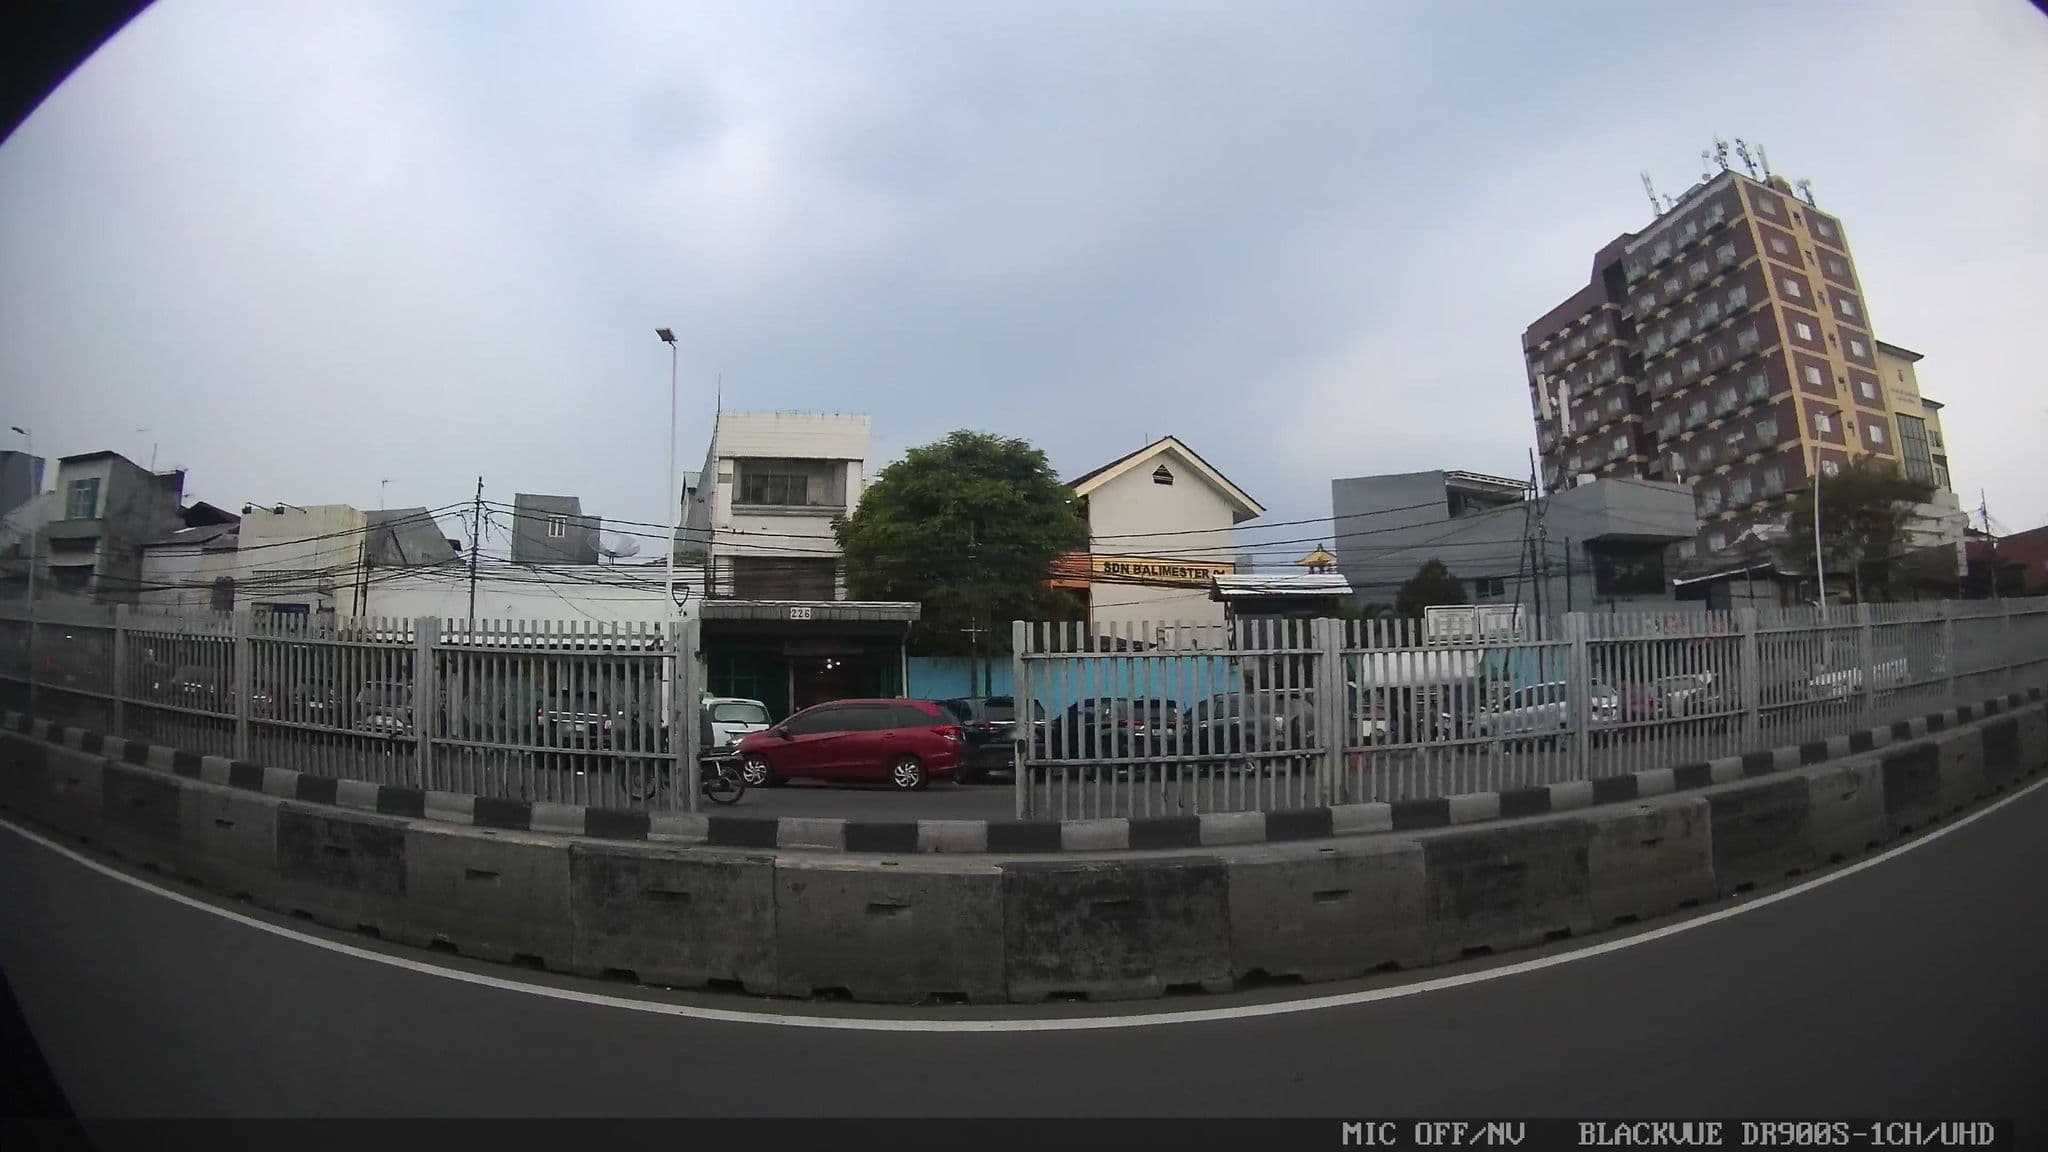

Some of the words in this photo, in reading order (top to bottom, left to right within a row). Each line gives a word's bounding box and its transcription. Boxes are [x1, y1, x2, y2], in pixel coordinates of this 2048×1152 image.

[1104, 561, 1129, 574] SDN
[1133, 564, 1210, 579] BALIMESTER
[791, 609, 809, 618] 226
